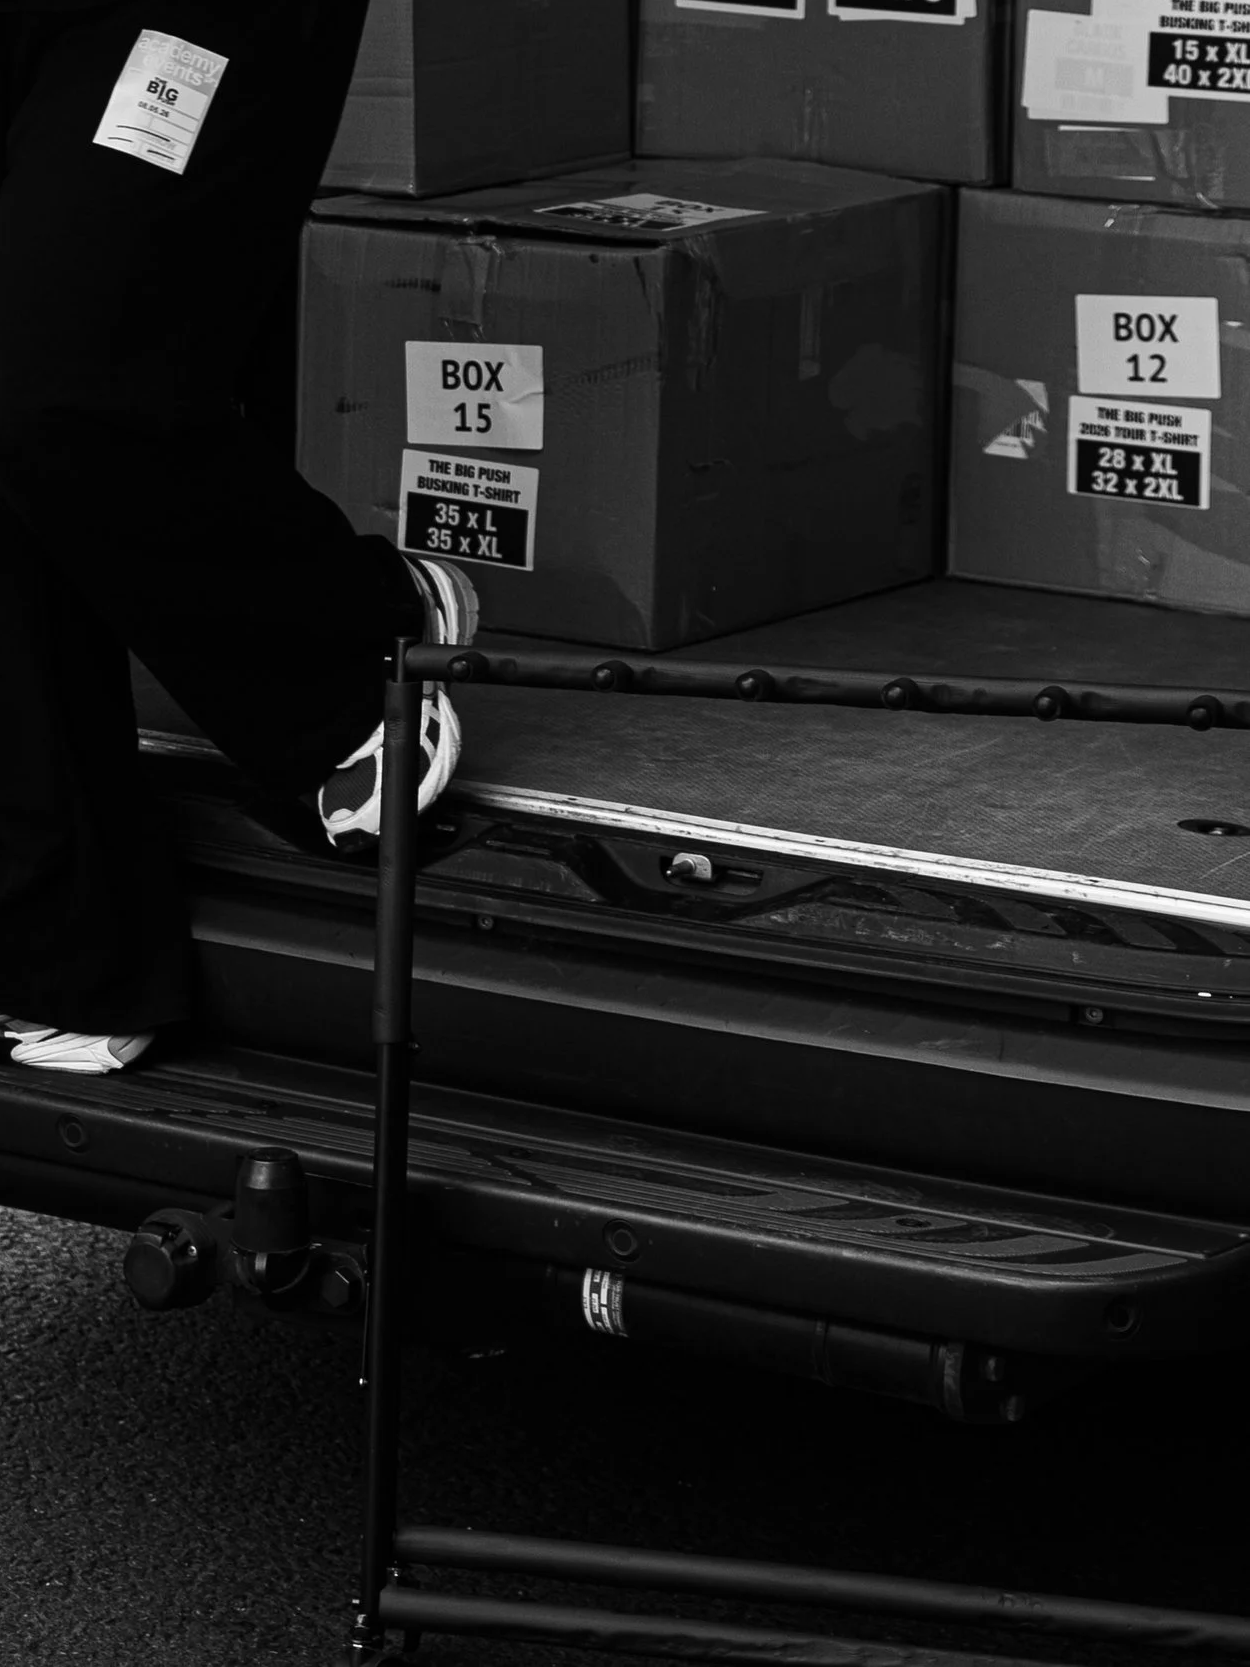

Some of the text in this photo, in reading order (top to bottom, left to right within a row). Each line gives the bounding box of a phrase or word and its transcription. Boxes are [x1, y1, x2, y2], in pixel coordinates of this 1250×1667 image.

[1199, 0, 1221, 13] BIG
[1224, 2, 1250, 15] PUS
[1159, 15, 1215, 31] BUSKING
[138, 37, 222, 76] academy
[1172, 39, 1250, 64] 15 x XL
[142, 54, 204, 86] events
[1163, 64, 1192, 85] 40
[1197, 70, 1211, 86] x
[146, 80, 180, 101] BIG
[1113, 312, 1179, 343] BOX
[441, 359, 504, 392] BOX
[1126, 353, 1168, 383] 12
[454, 402, 492, 434] 15
[1097, 406, 1182, 427] THE BIG PUSH
[1150, 430, 1199, 446] T-SHIRT
[428, 459, 511, 484] THE BIG PUSH
[1098, 447, 1178, 475] 28 x XL
[417, 475, 521, 504] BUSKING T-SHIRT
[1091, 470, 1184, 501] 32 x 2XL
[435, 503, 497, 532] 35 x L
[427, 527, 502, 558] 35 x XL
